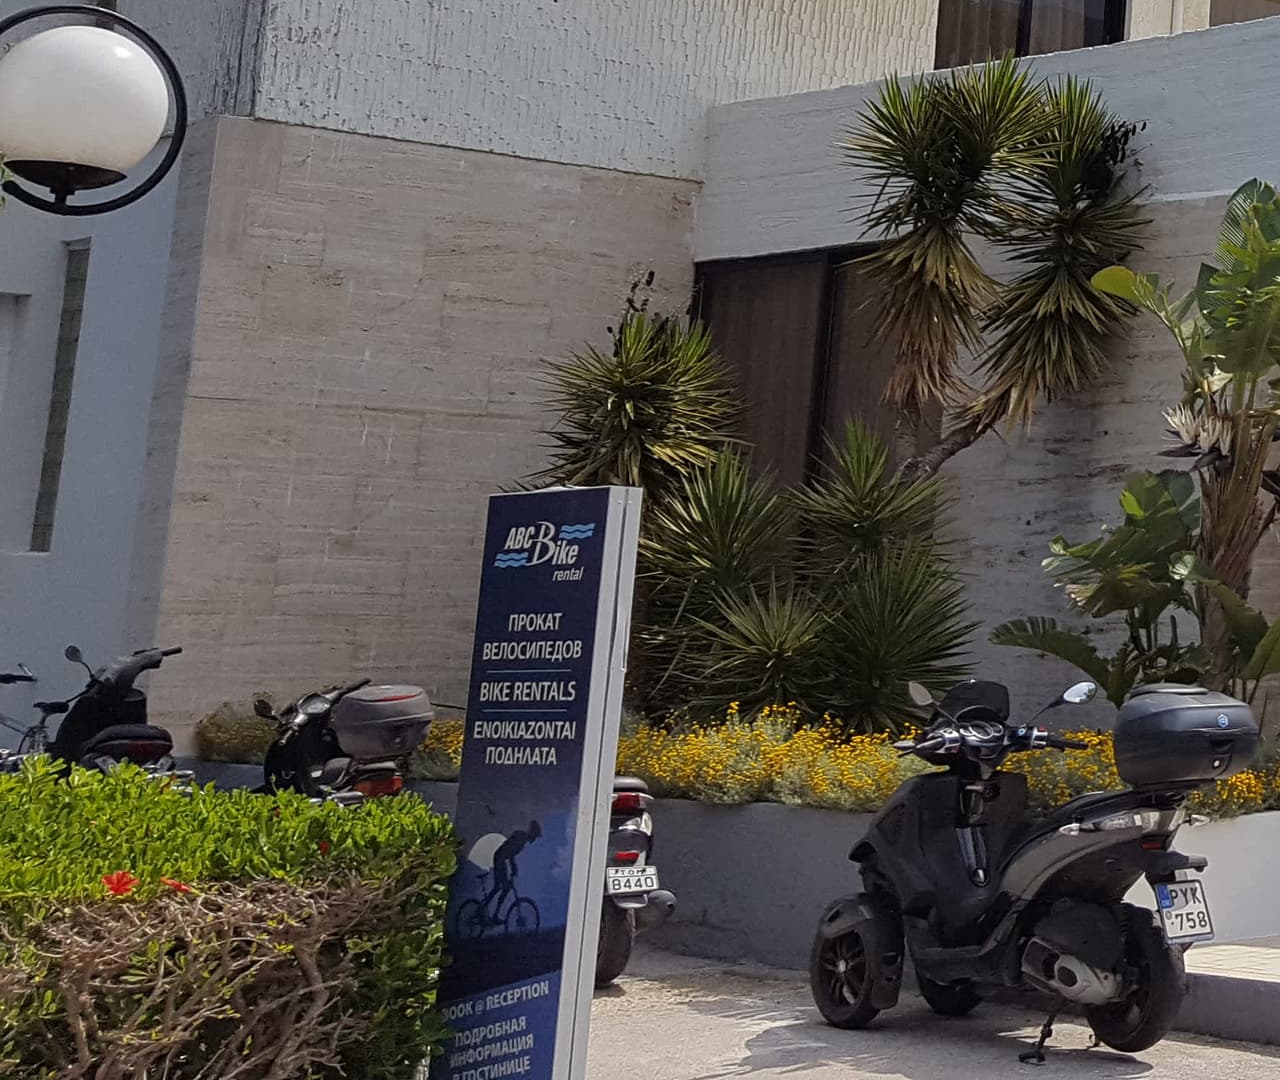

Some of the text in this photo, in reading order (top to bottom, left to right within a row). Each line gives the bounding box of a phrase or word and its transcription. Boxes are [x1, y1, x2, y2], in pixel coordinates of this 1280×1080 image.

[504, 521, 579, 567] ABC Bike
[552, 566, 585, 582] rental
[508, 613, 563, 632] ПРОКАТ
[482, 640, 582, 662] ВЕЛОСИПЕДОВ
[480, 681, 577, 702] BIKE RENTALS
[473, 721, 577, 740] ΕΝΟΙΚΙΑΖΟΝΤΑΙ
[485, 746, 557, 765] ΠΟΔΗΛΑΤΑ
[612, 876, 654, 890] 8440
[1169, 886, 1202, 906] PYK
[1174, 910, 1208, 931] 758
[486, 980, 549, 1010] RECEPTION
[455, 1016, 527, 1047] ПОДРОБНАЯ
[450, 1033, 534, 1069] ИНФОРМАЦИЯ
